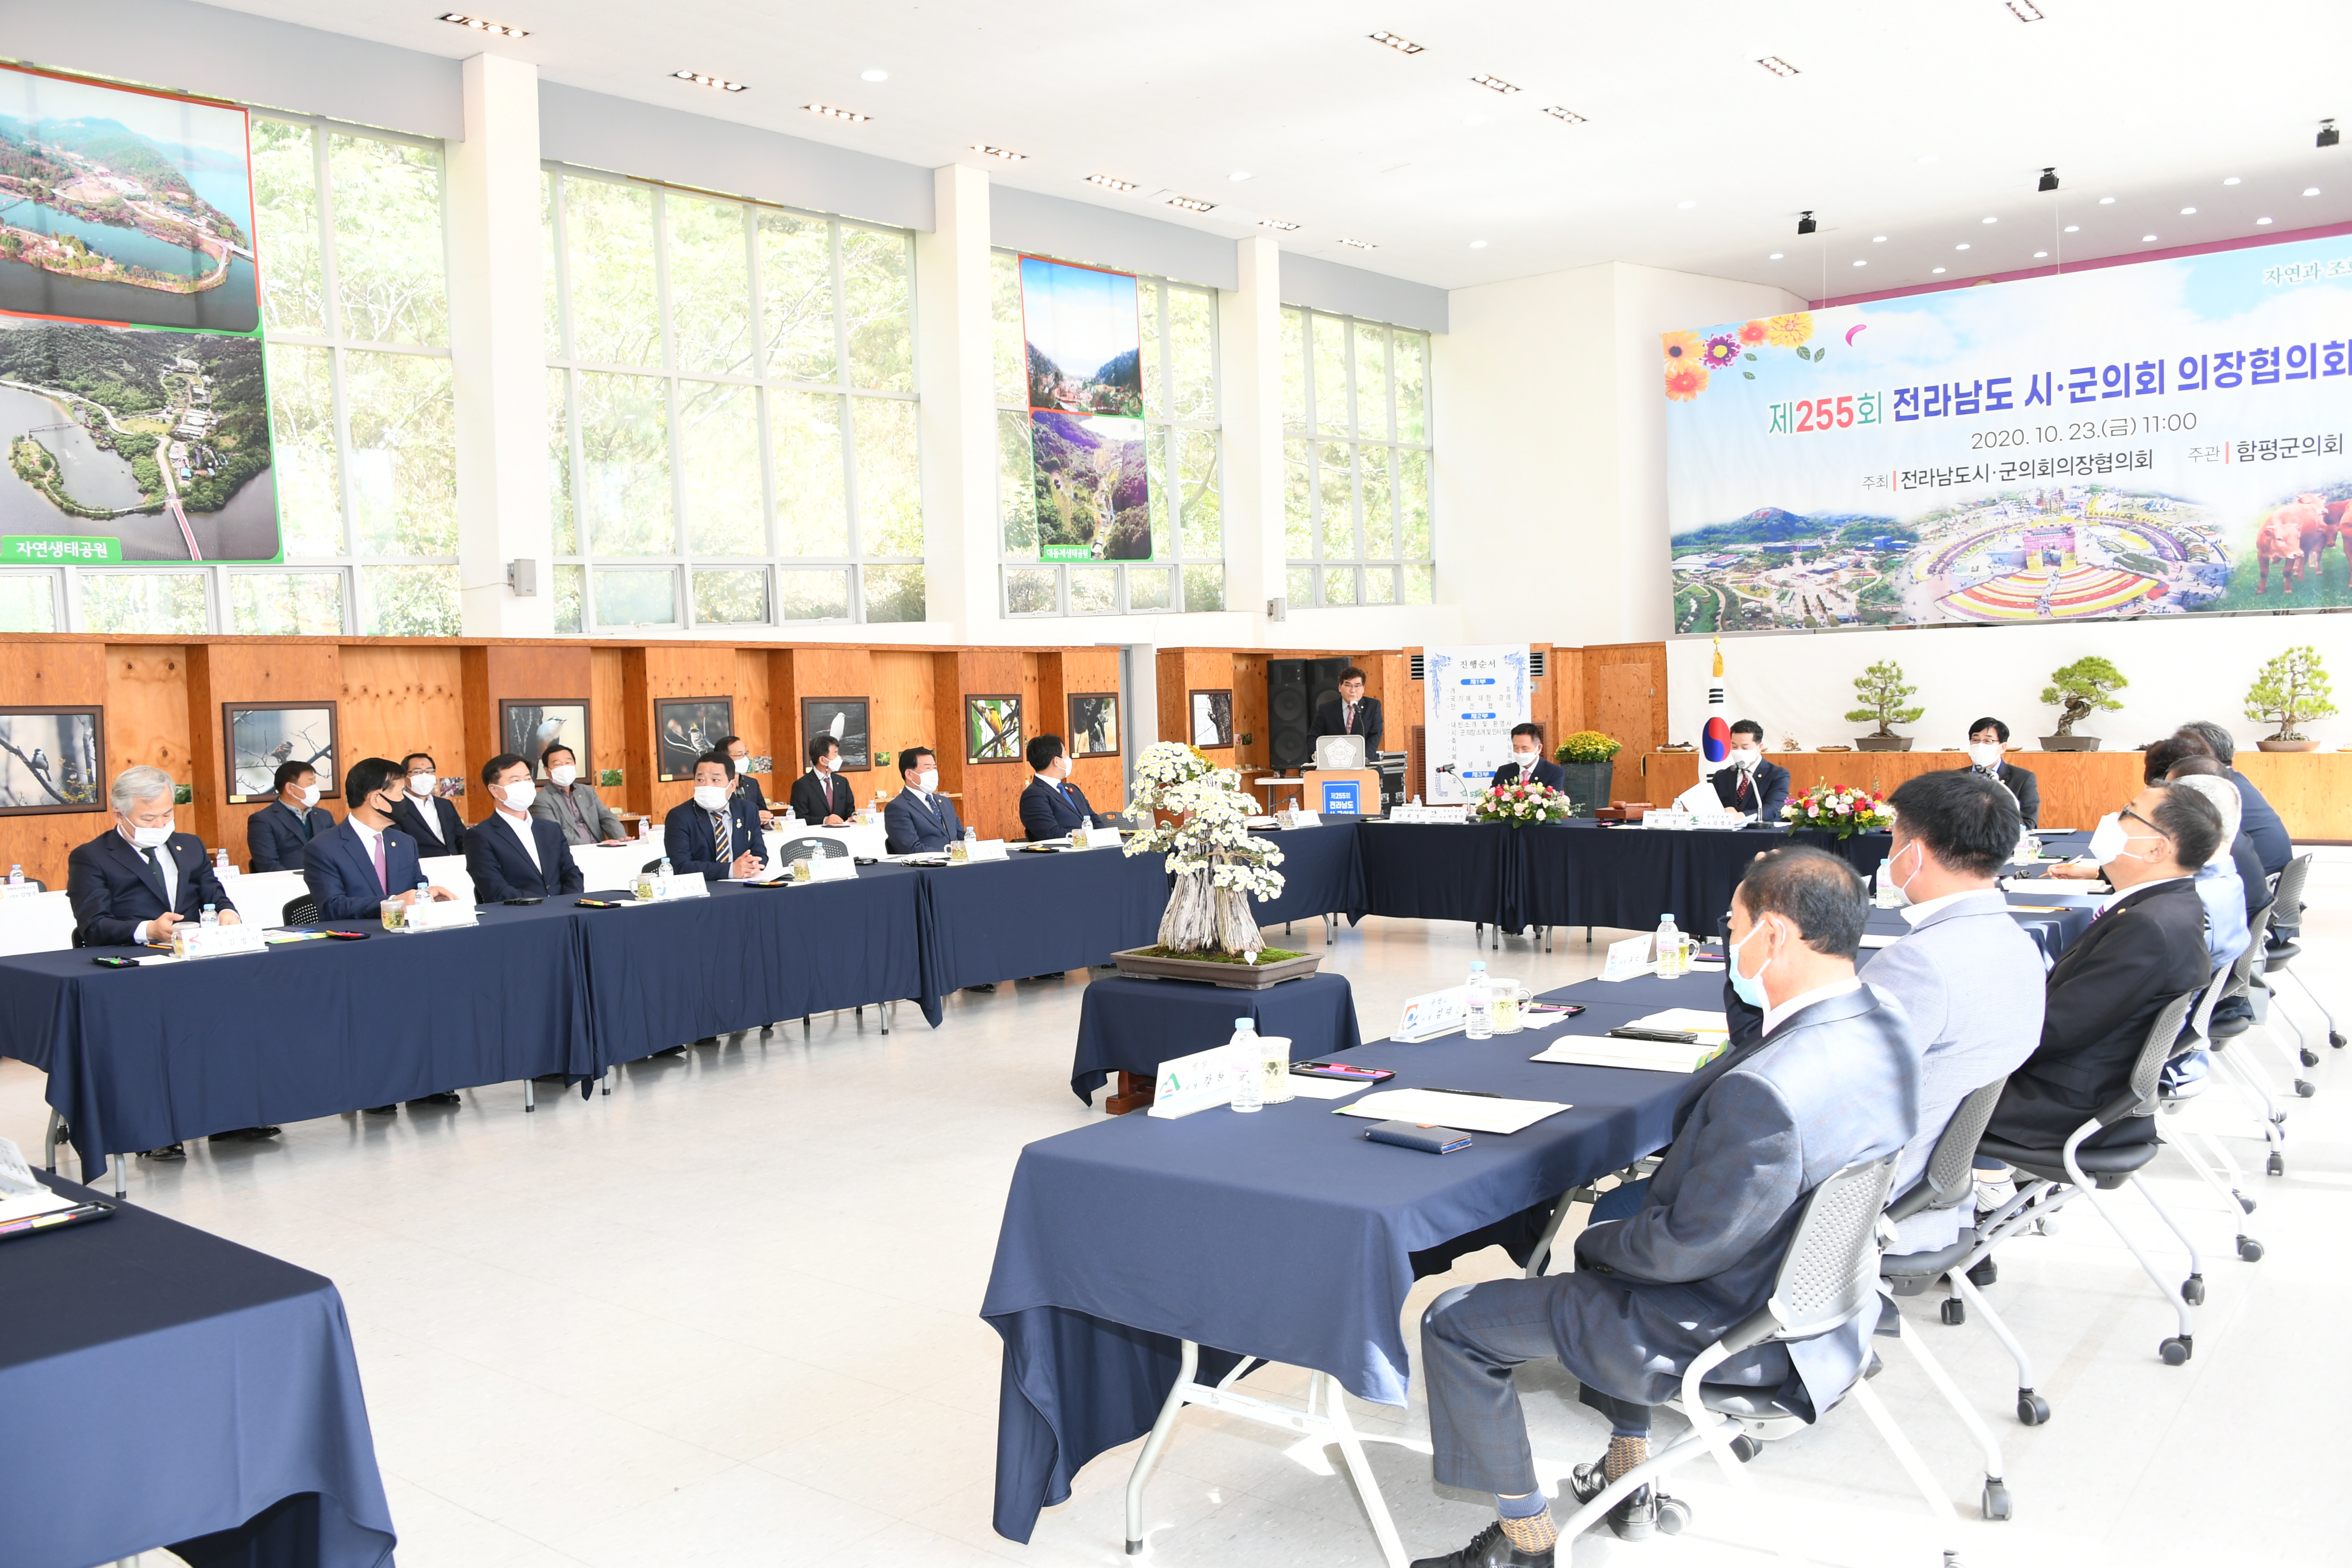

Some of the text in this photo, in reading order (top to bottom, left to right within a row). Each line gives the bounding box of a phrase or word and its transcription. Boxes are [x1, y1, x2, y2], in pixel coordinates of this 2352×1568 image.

[2265, 262, 2322, 285] 자연과
[1769, 338, 2352, 434] 제255회 전라남도 시·군의회 의장협의회
[1971, 429, 2029, 450] 2020.
[2036, 425, 2063, 444] 10.
[2142, 412, 2197, 434] 11:00
[2187, 433, 2343, 463] 주관 함평군의회
[1861, 449, 2153, 491] 주최 전라남도시·군의회의장협의회
[16, 541, 108, 558] 자연생태공원
[1046, 548, 1088, 559] 대동제생태공원
[1460, 659, 1495, 669] 진행순서
[1329, 801, 1354, 809] 전라남도
